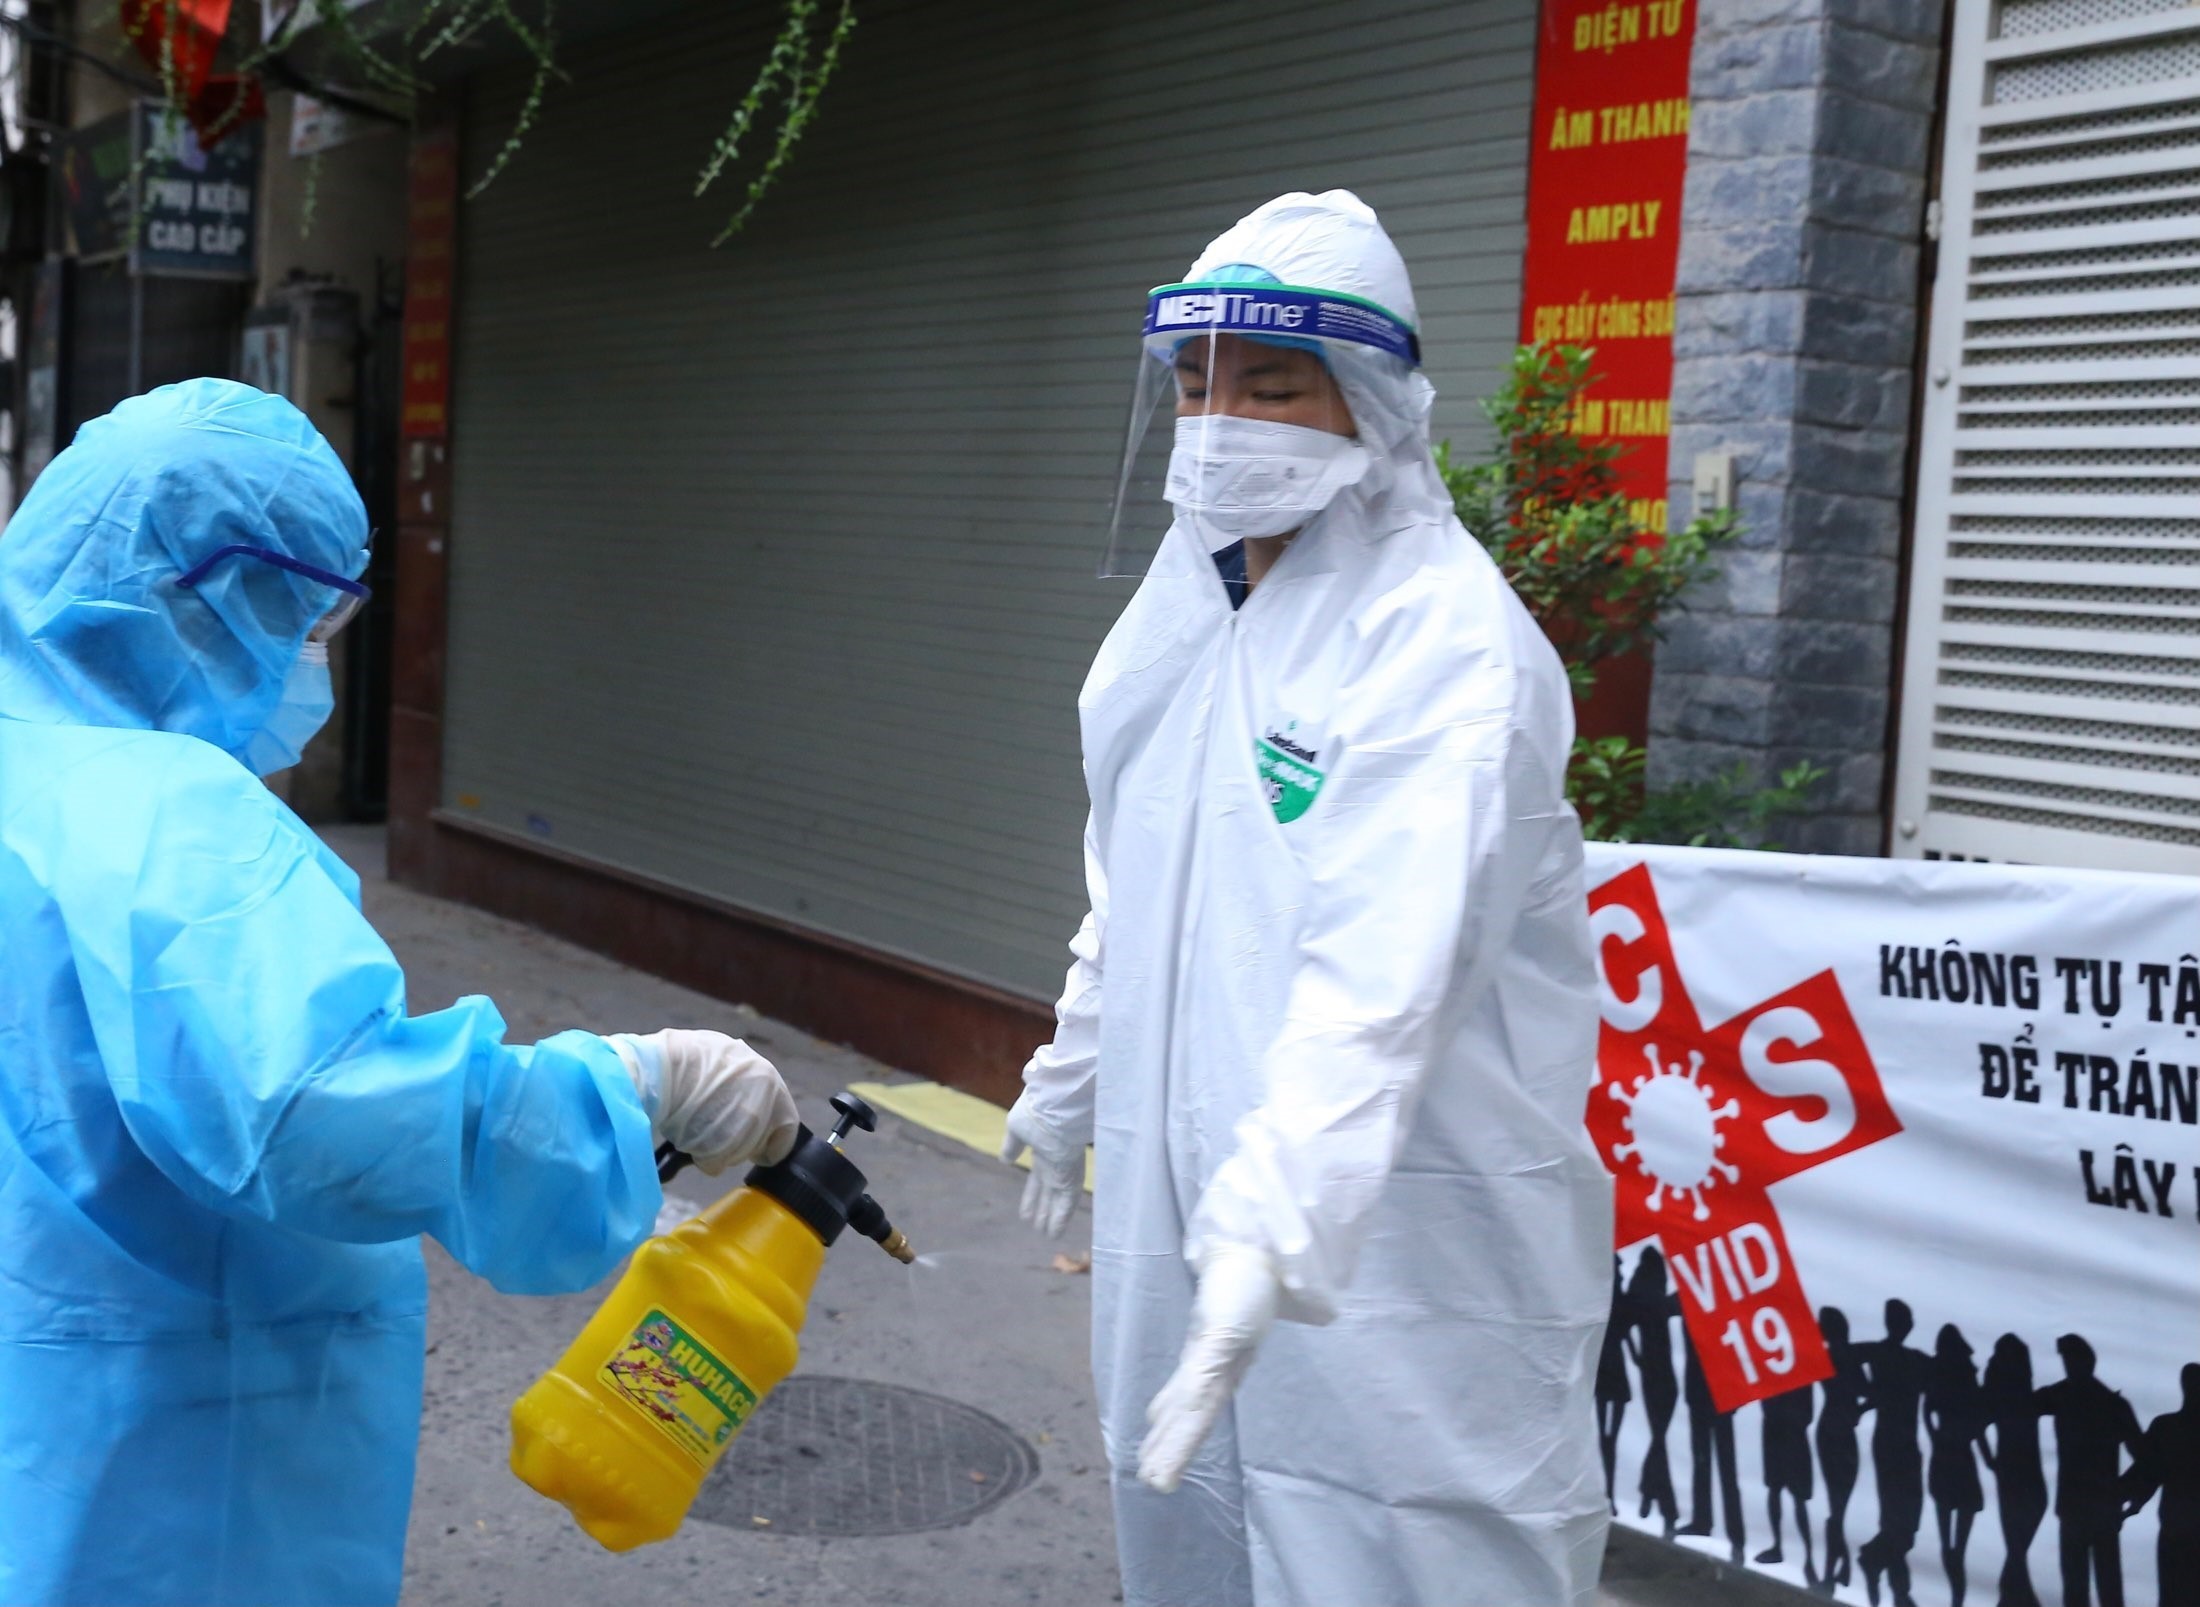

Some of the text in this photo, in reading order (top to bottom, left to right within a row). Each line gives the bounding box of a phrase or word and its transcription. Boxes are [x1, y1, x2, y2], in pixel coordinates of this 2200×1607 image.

[1550, 98, 1692, 149] ÂM THANH
[149, 221, 196, 252] CAO
[1567, 201, 1661, 243] AMPLY
[1880, 938, 2039, 1010] KHÔNG
[2055, 957, 2121, 1028] TỤ
[1739, 1006, 1857, 1154] S
[1979, 1023, 2040, 1103] ĐỂ
[2080, 1143, 2175, 1217] LÂY
[1671, 1221, 1780, 1314] VID
[1721, 1306, 1795, 1385] 19
